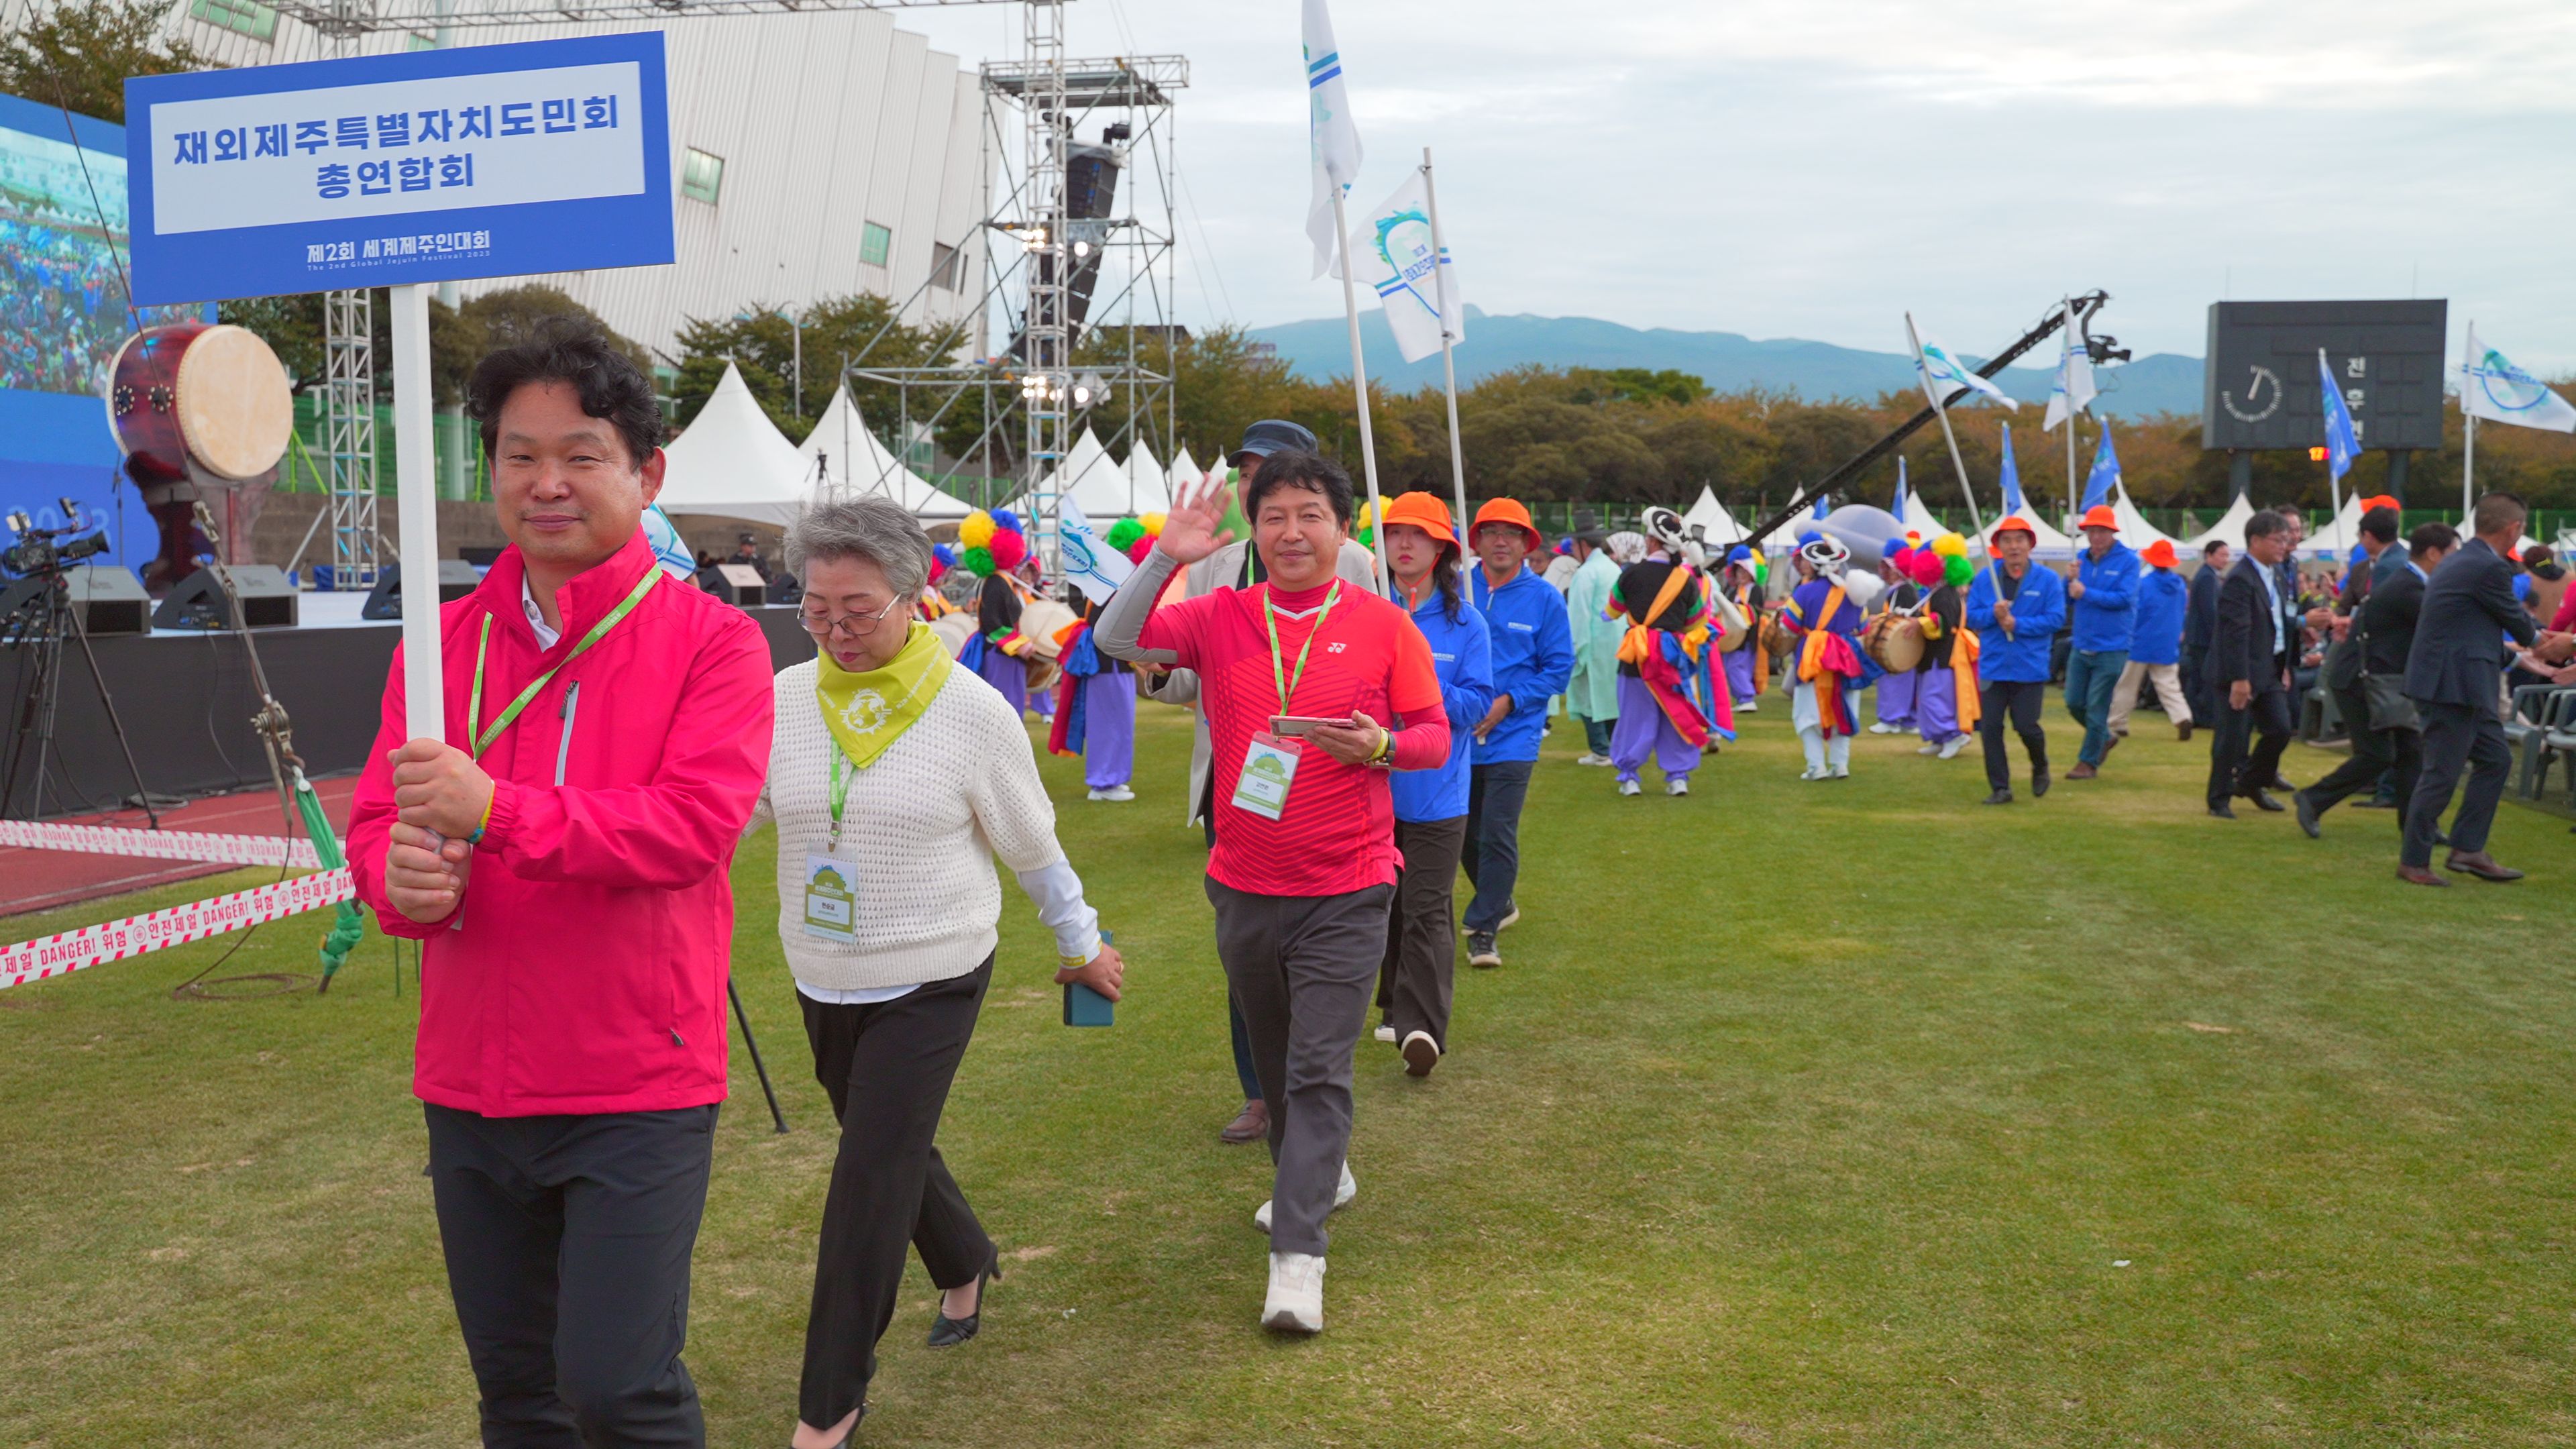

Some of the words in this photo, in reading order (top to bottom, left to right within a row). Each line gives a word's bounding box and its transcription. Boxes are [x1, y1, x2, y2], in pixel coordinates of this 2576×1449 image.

[173, 93, 619, 166] 재외제주특별자치도민회
[316, 152, 475, 200] 총연합회
[307, 241, 355, 263] 제2회
[362, 229, 490, 258] 세계제주인대회
[350, 258, 383, 268] Global
[422, 252, 464, 262] Festival
[467, 250, 491, 258] 2023
[2345, 388, 2366, 411] 후
[0, 953, 33, 973] 제일
[40, 938, 97, 965] DANGER!
[103, 930, 127, 951] 위험
[148, 913, 197, 939] 안전제일
[203, 901, 249, 925] DANGER!
[254, 896, 274, 913] 위험
[291, 881, 331, 904] 안전제일
